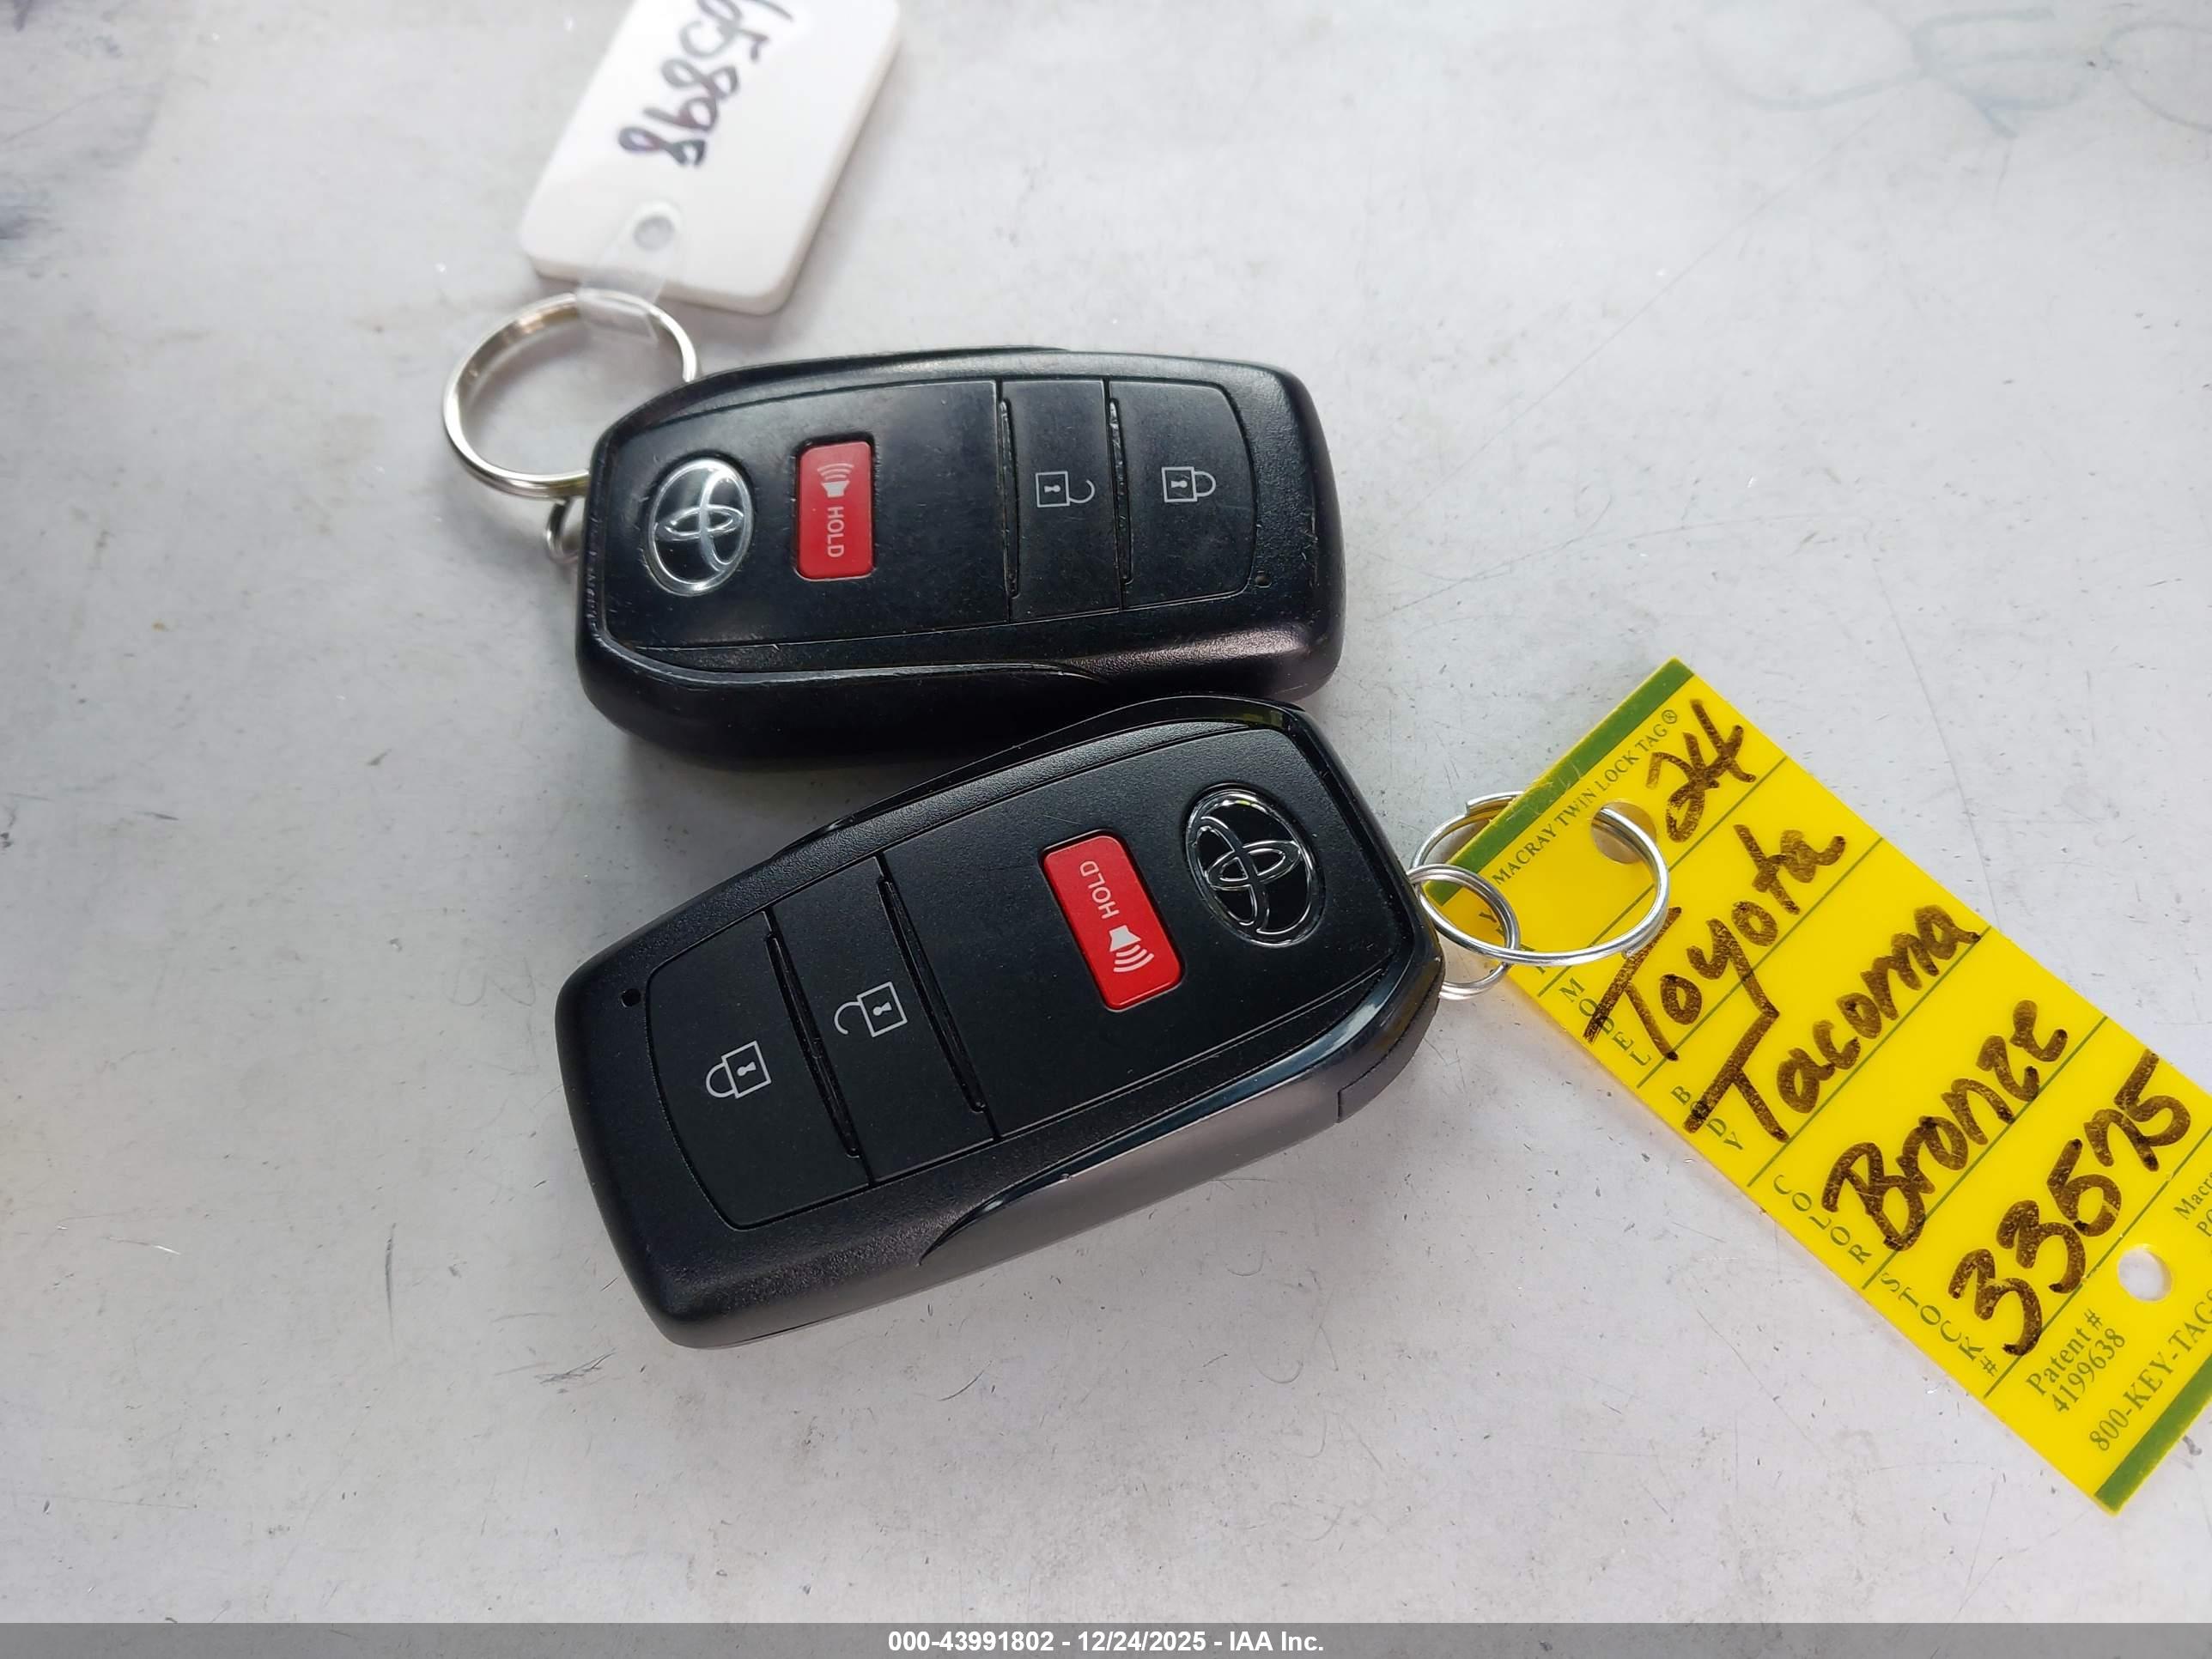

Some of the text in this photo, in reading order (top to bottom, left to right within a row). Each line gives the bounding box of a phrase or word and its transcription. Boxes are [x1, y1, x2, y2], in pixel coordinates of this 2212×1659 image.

[827, 506, 844, 558] HOLD
[1645, 698, 1756, 842] 24
[1492, 823, 1557, 885] MACRAY
[1554, 788, 1597, 827] TWIN
[1595, 750, 1639, 792] LOCK
[1079, 860, 1120, 919] HOLD
[1583, 823, 1846, 1061] Toyota
[1559, 977, 1651, 1066] MODEL
[1683, 904, 1982, 1143] Tacoma
[1670, 1085, 1743, 1151] BODY
[1821, 1000, 2068, 1251] Bronze
[1773, 1174, 1872, 1265] COLOR
[2173, 1171, 2212, 1220] Macr
[2026, 1309, 2103, 1396] Patent #
[2051, 1328, 2126, 1414] 4199638
